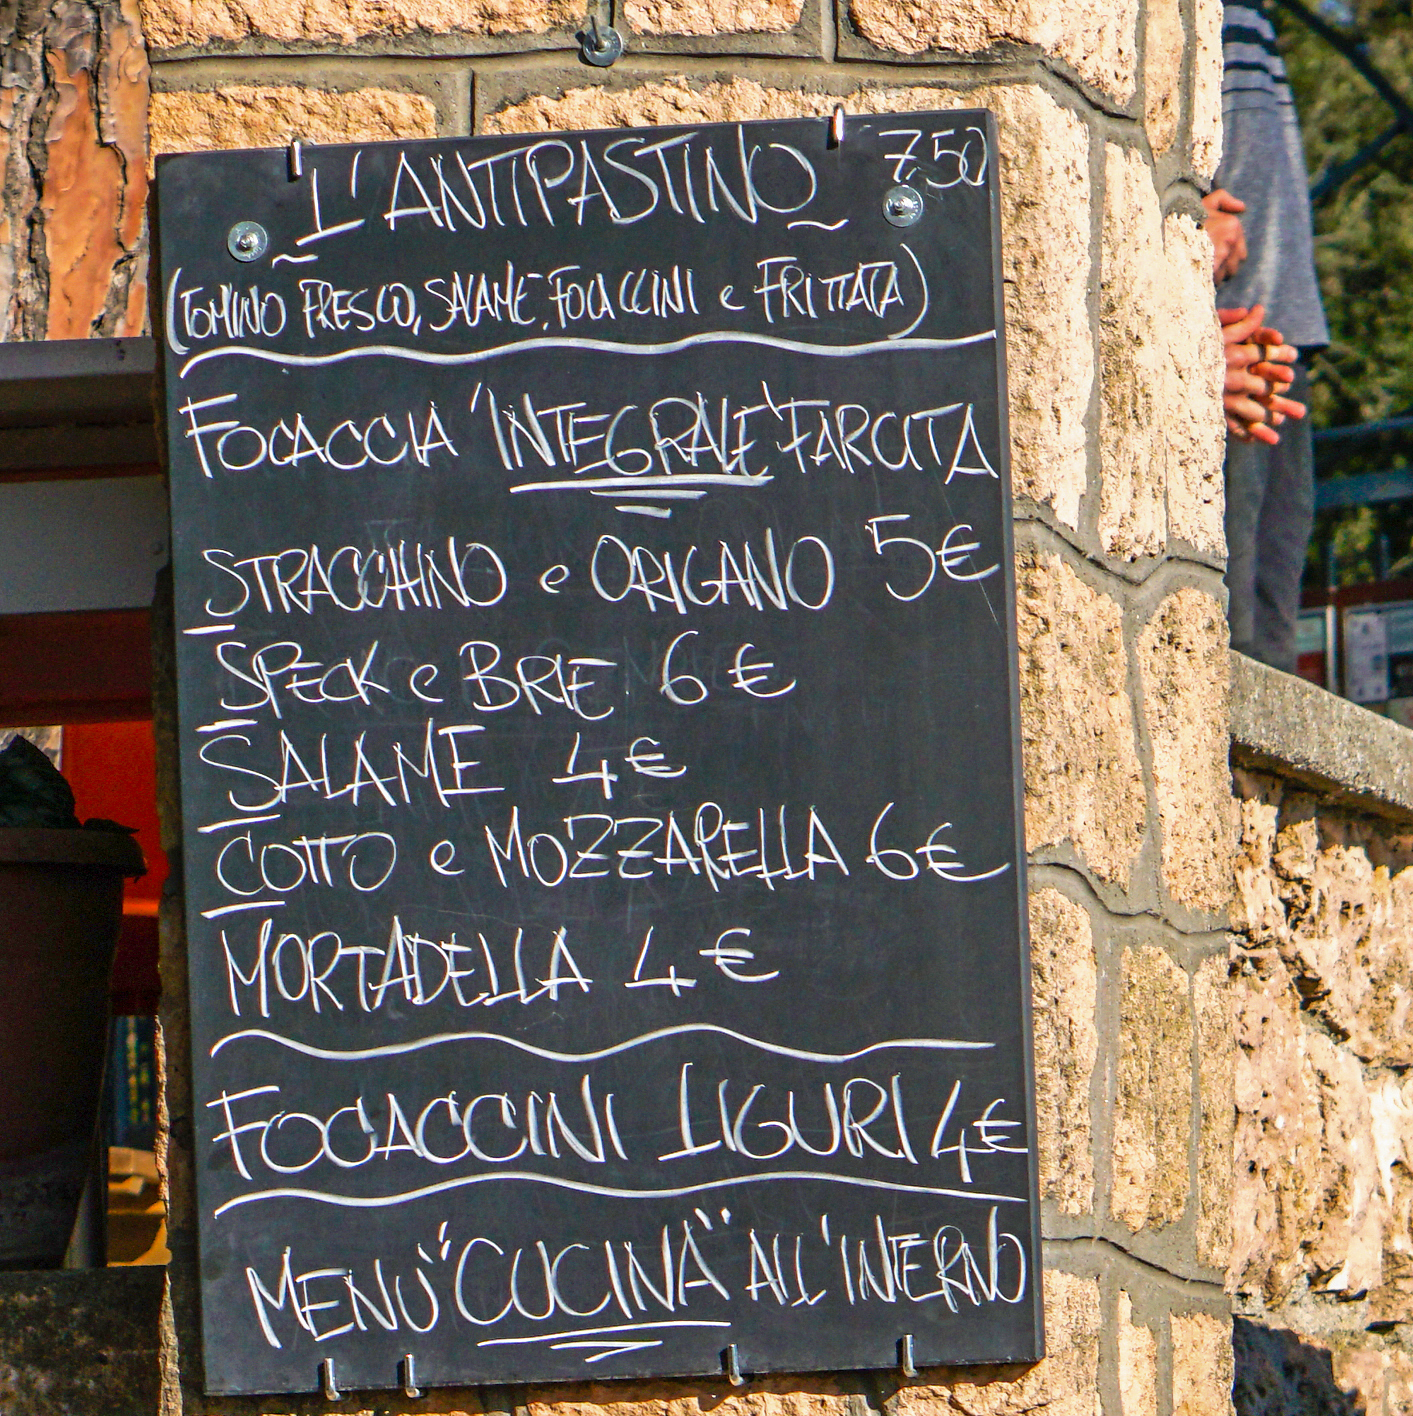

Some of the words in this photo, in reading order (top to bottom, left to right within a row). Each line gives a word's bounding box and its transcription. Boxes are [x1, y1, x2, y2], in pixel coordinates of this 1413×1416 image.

[879, 126, 988, 189] 7,50
[548, 265, 699, 329] FOCACCINI
[178, 393, 458, 479] FOCACCIA
[202, 540, 507, 616] STRACCHINO
[540, 564, 570, 595] e
[591, 528, 834, 614] ORIGANO
[216, 640, 391, 720] SPECK
[409, 663, 444, 704] e
[460, 640, 616, 721] BRIE
[200, 718, 505, 812] SALAME
[216, 830, 397, 894] COTTO
[431, 840, 465, 875] e
[486, 802, 850, 893] MOZZARELLA
[222, 915, 593, 1018] MORTADELLA
[206, 1074, 628, 1180] FOCACCINI
[659, 1061, 919, 1166] LIGURI
